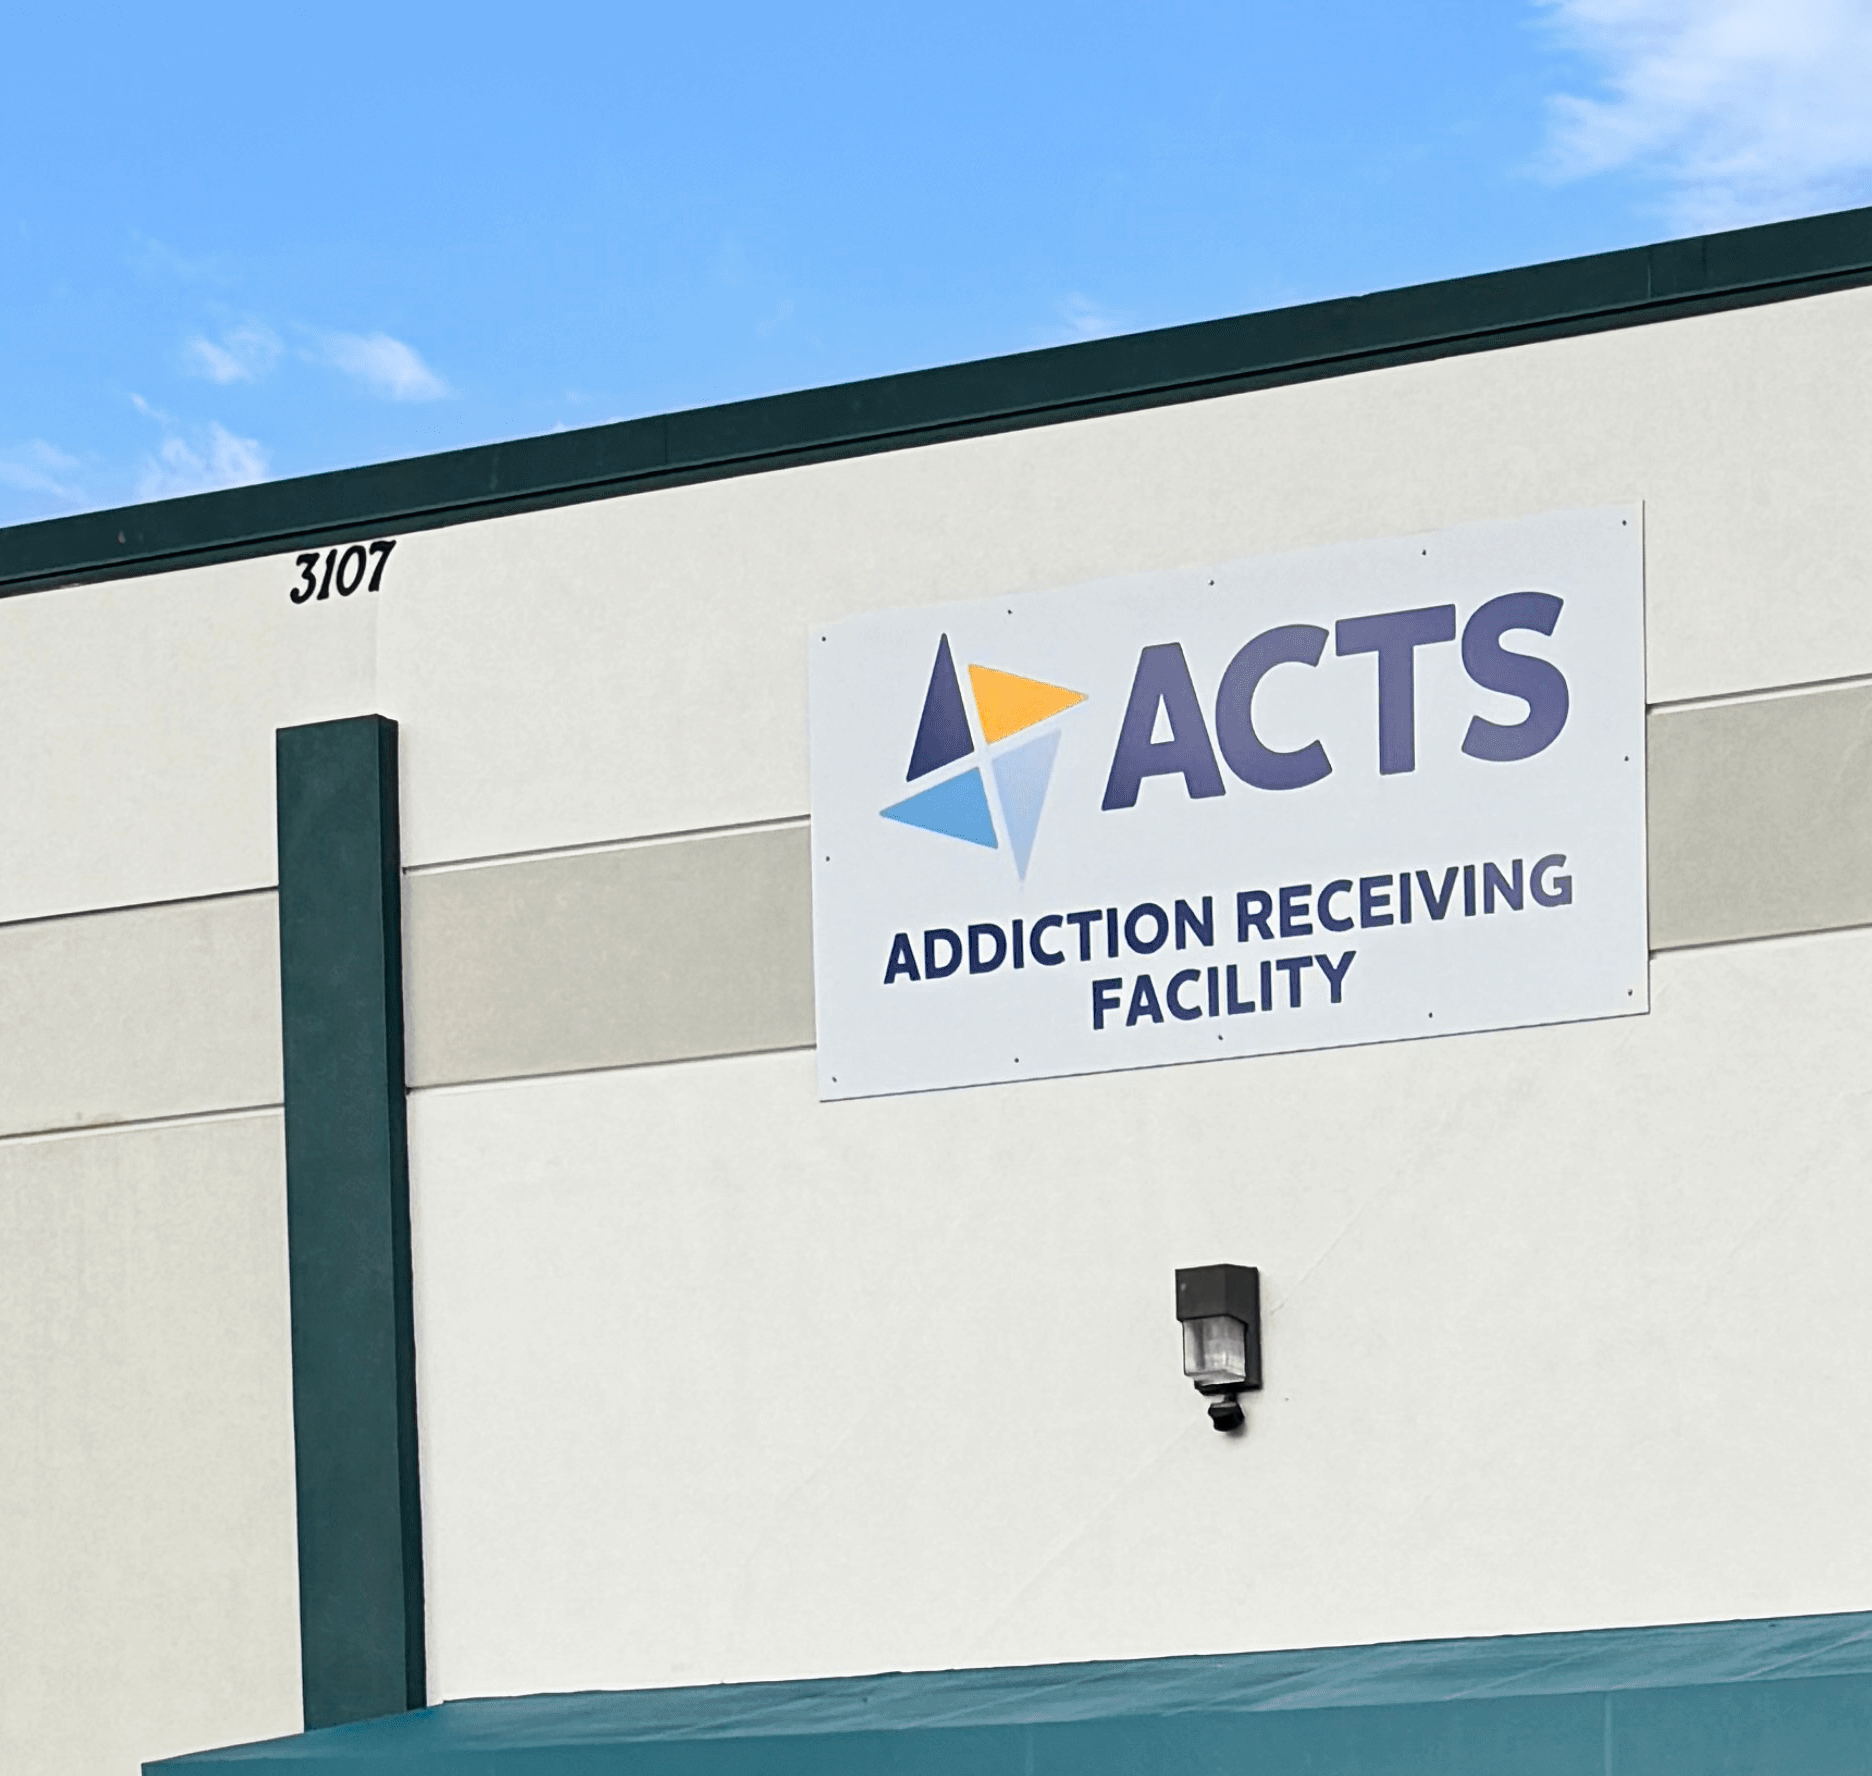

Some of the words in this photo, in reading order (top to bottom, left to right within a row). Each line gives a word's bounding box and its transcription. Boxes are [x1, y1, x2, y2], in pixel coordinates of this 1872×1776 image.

[290, 539, 397, 605] 3107
[1101, 591, 1570, 812] ACTS
[883, 895, 1215, 985] ADDICTION
[1237, 854, 1574, 943] RECEIVING
[1092, 951, 1357, 1031] FACILITY
